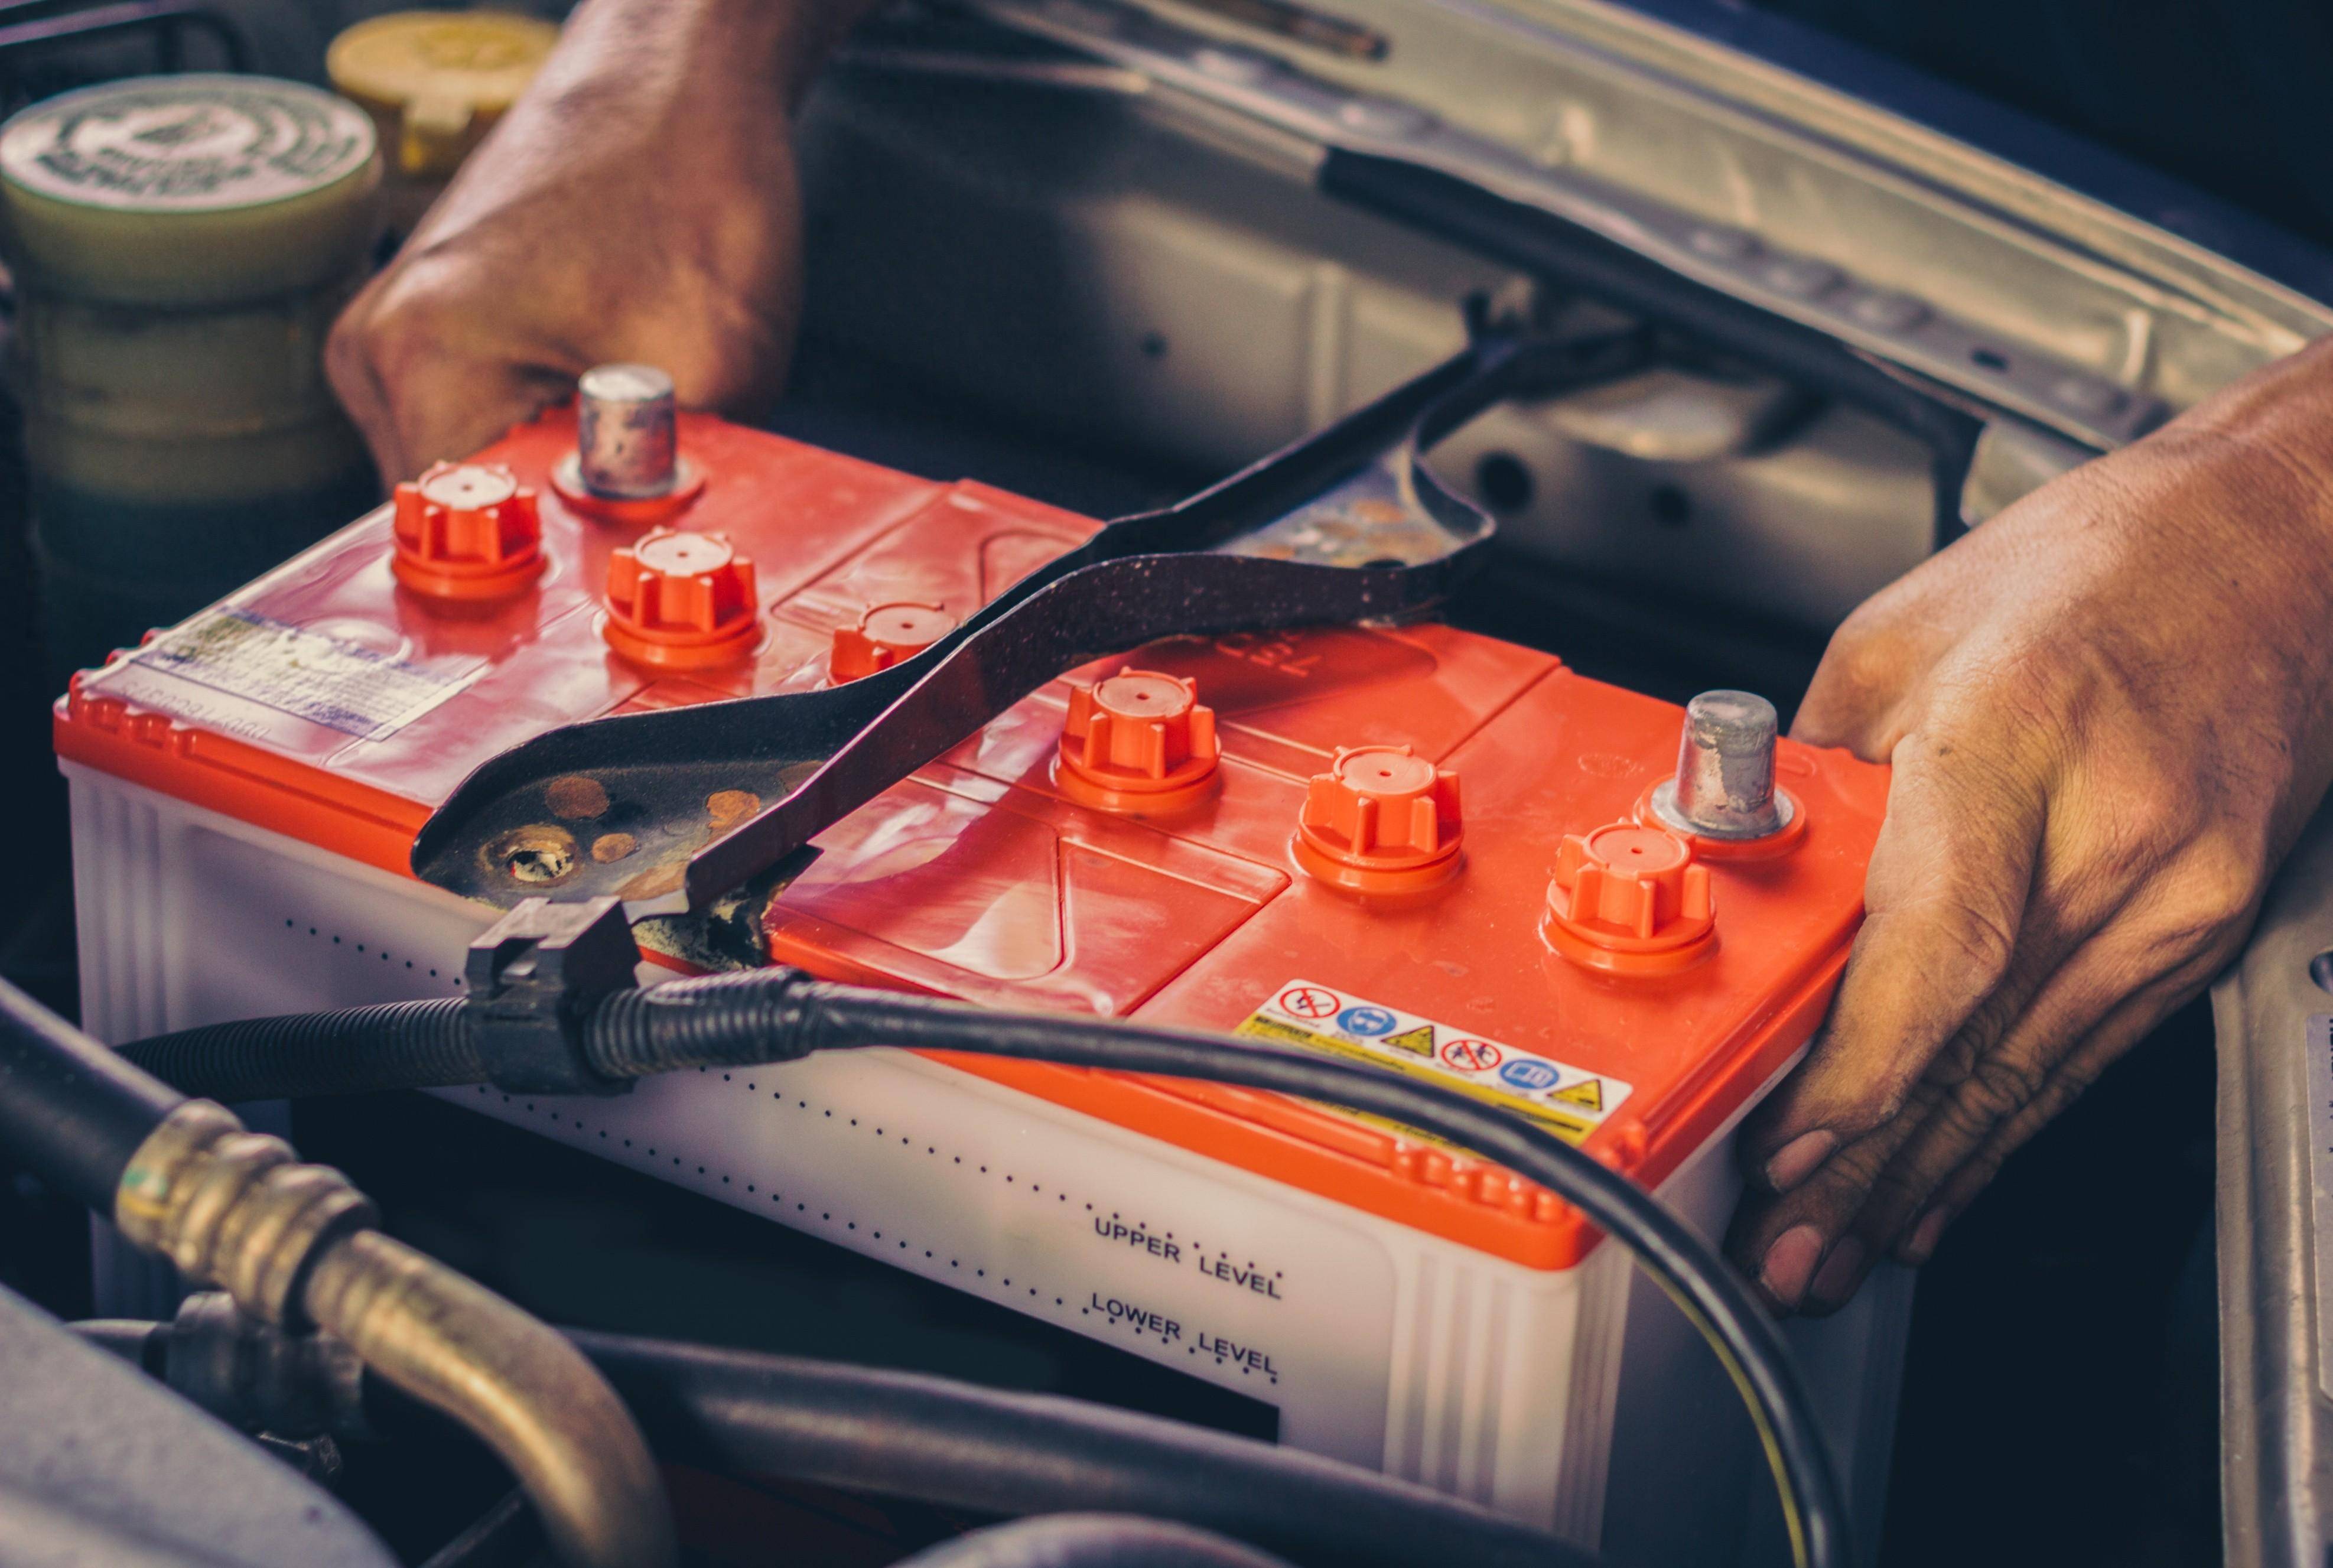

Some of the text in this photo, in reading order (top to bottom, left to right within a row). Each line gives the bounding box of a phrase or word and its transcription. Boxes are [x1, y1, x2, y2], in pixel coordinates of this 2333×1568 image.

[1095, 1217, 1281, 1300] UPPER LEVEL
[1092, 1293, 1277, 1375] LOWER LEVEL
